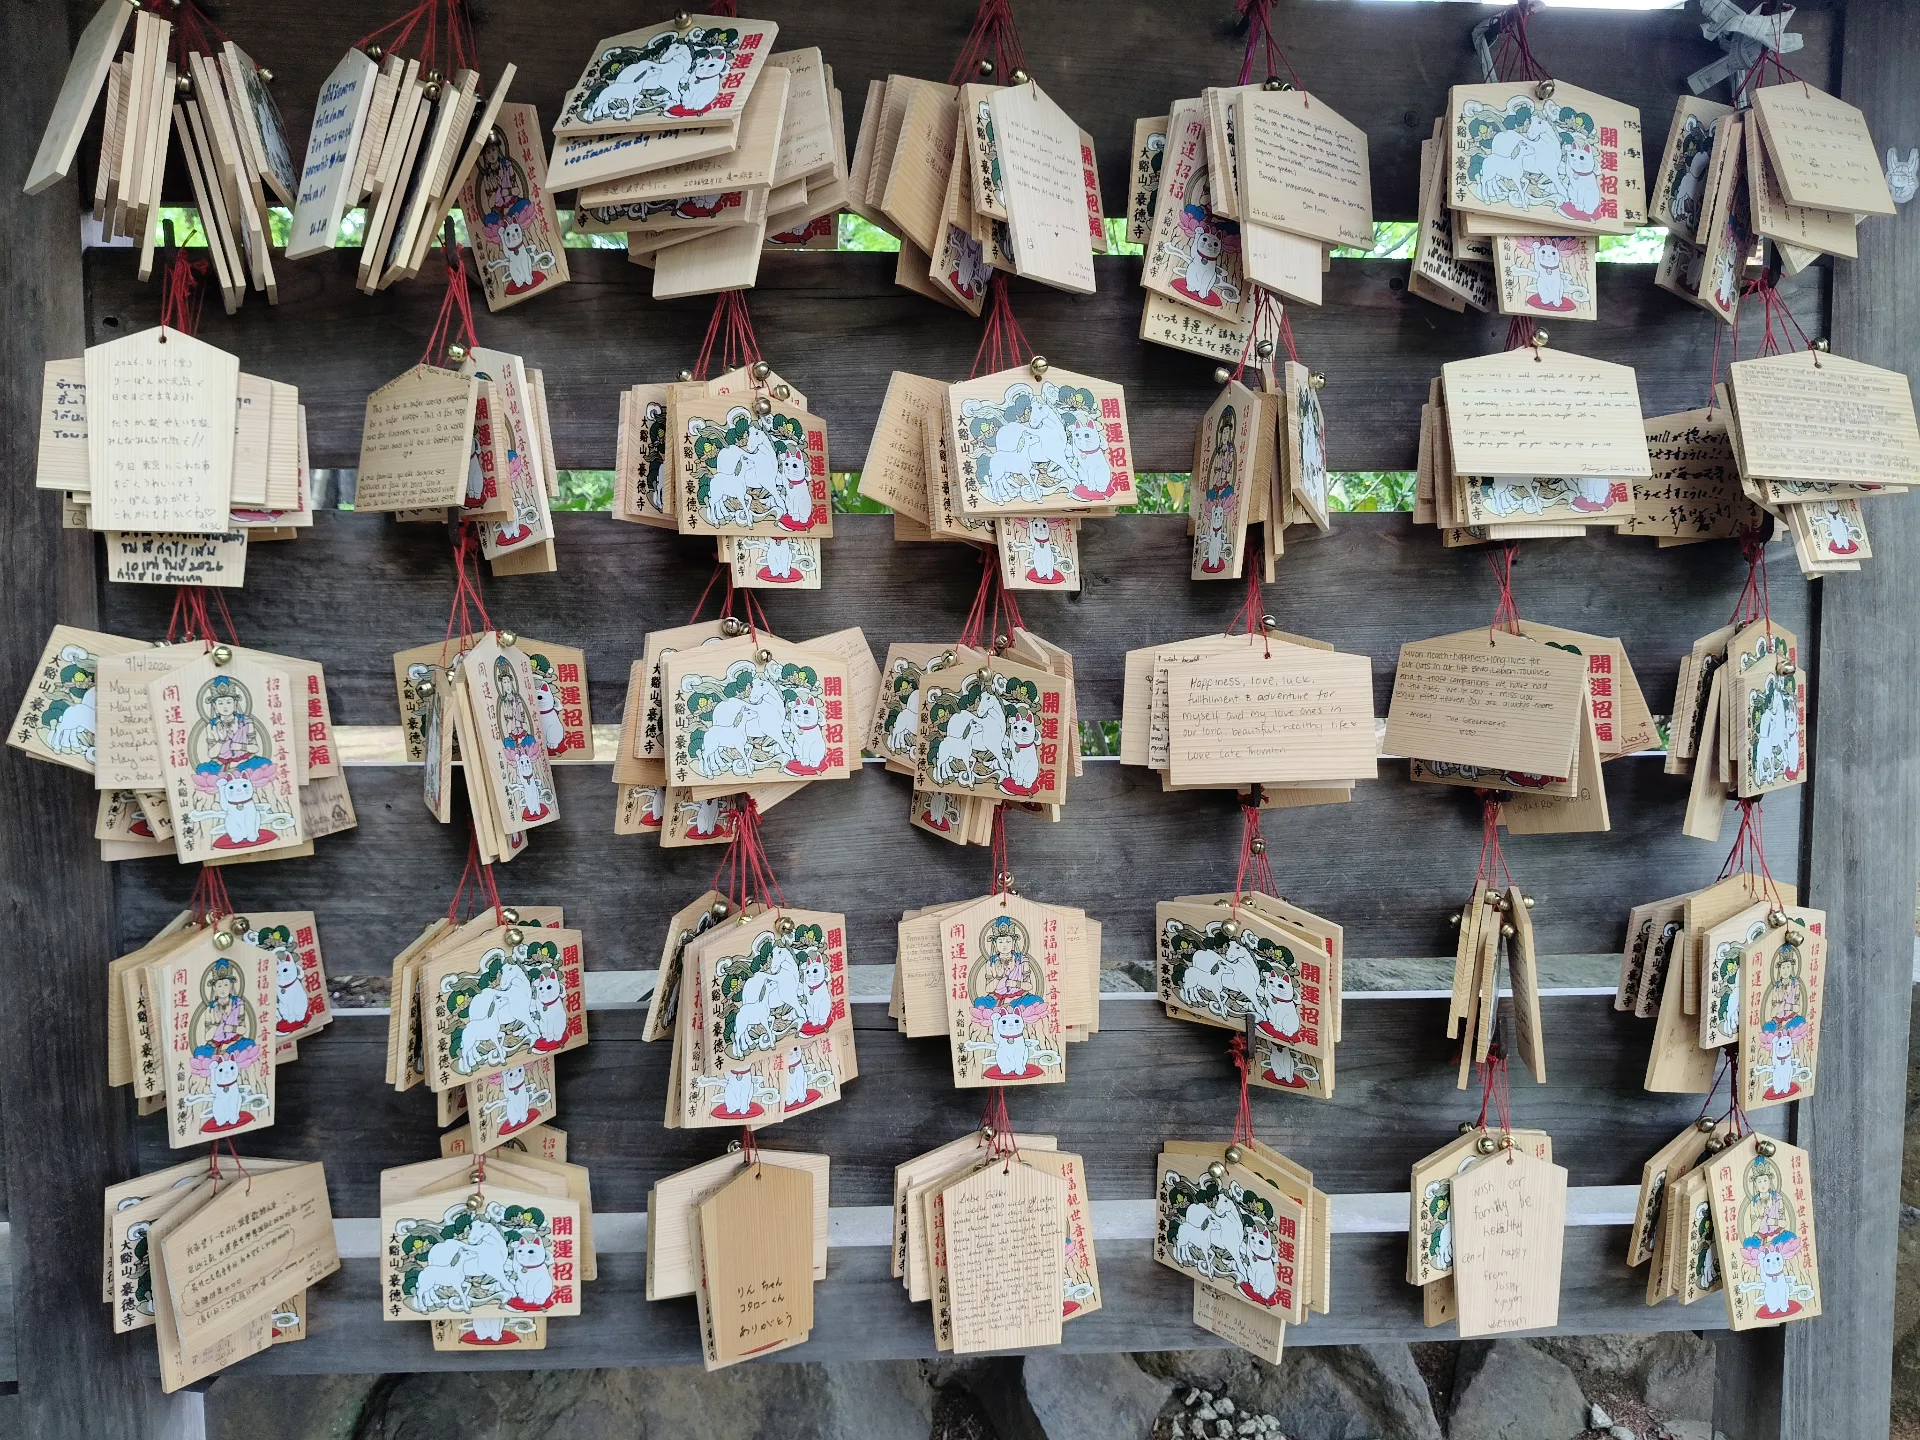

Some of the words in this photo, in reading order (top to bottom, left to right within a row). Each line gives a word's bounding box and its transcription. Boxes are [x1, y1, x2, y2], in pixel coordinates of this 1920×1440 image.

[713, 33, 763, 109] 開運招福
[1457, 113, 1467, 150] 大谿山
[1455, 156, 1468, 202] 豪徳寺
[1600, 126, 1618, 220] 開運招福
[639, 416, 648, 457] 大谿山
[684, 432, 694, 472] 大谿山
[957, 415, 970, 454] 大谿山
[1101, 398, 1131, 492] 開運招福
[637, 462, 647, 512] 豪徳寺
[808, 430, 828, 525] 開運招福
[962, 461, 979, 509] 豪徳寺
[685, 480, 698, 529] 豪徳寺
[110, 679, 131, 702] May
[557, 663, 585, 749] 開運招福
[882, 667, 894, 701] 大谿山
[1257, 691, 1309, 701] adventure
[1317, 690, 1335, 699] for
[1589, 655, 1612, 742] 開運招福
[110, 701, 133, 716] May
[163, 685, 189, 768] 開運招福
[674, 689, 686, 729] 大谿山
[824, 676, 844, 768] 開運招福
[872, 707, 886, 750] 豪徳寺
[921, 702, 929, 736] 大谿山
[1182, 710, 1220, 728] myself
[1227, 710, 1244, 721] and
[1251, 710, 1266, 724] my
[1274, 708, 1294, 718] love
[110, 727, 134, 742] May
[266, 677, 293, 796] 招福観世音菩薩
[407, 717, 423, 759] 豪徳寺
[674, 734, 688, 782] 豪徳寺
[1038, 692, 1060, 791] 開運招福
[111, 754, 138, 770] May
[917, 742, 928, 787] 豪徳寺
[296, 926, 325, 1016] 開運招福
[827, 928, 846, 1021] 開運招福
[950, 923, 968, 1000] 開運招福
[1043, 918, 1061, 1034] 招福観世音菩薩
[173, 968, 190, 1052] 開運招福
[435, 991, 447, 1032] 大谿山
[562, 945, 583, 1037] 開運招福
[711, 977, 722, 1016] 大谿山
[1299, 961, 1320, 1047] 開運招福
[1750, 952, 1763, 1027] 開運招福
[1806, 943, 1821, 1052] 招福観世音菩薩
[257, 959, 271, 1076] 招福観世音菩薩
[437, 1037, 450, 1085] 豪徳寺
[712, 1021, 724, 1071] 豪徳寺
[1720, 1166, 1738, 1243] 開運招福
[1792, 1156, 1813, 1269] 招福観世音菩薩
[120, 1241, 133, 1277] 大谿山
[389, 1235, 400, 1268] 大谿山
[552, 1216, 573, 1305] 開運招福
[1276, 1216, 1296, 1309] 開運招福
[1483, 1269, 1508, 1282] from
[120, 1282, 136, 1327] 豪徳寺
[388, 1274, 401, 1317] 豪徳寺
